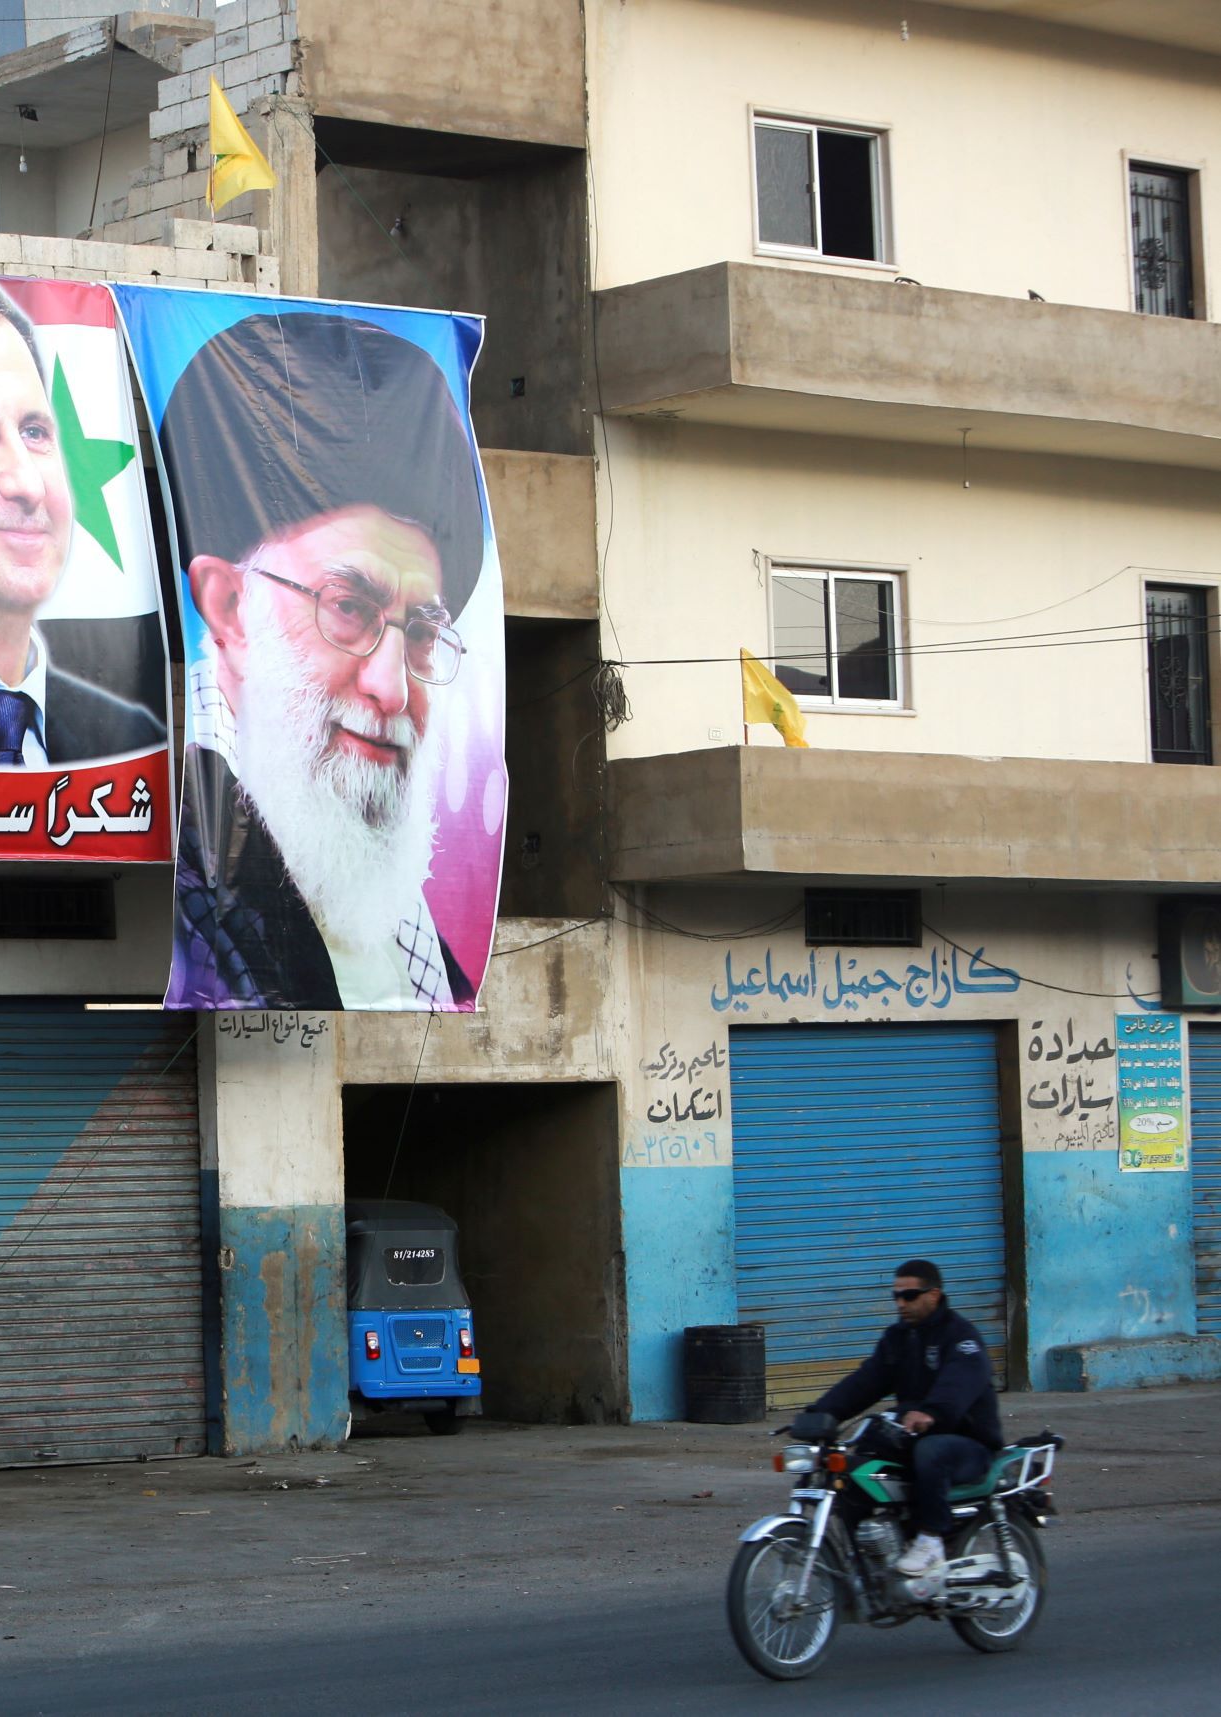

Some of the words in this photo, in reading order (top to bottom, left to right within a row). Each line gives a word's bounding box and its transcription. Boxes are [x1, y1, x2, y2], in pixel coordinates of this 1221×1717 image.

[711, 946, 817, 1012] اسماعيل
[905, 945, 1021, 1009] كاراج
[1124, 1018, 1147, 1033] خاص
[1149, 1018, 1175, 1033] عرض
[687, 1040, 726, 1084] تلحيم
[647, 1087, 723, 1123] اشكمان
